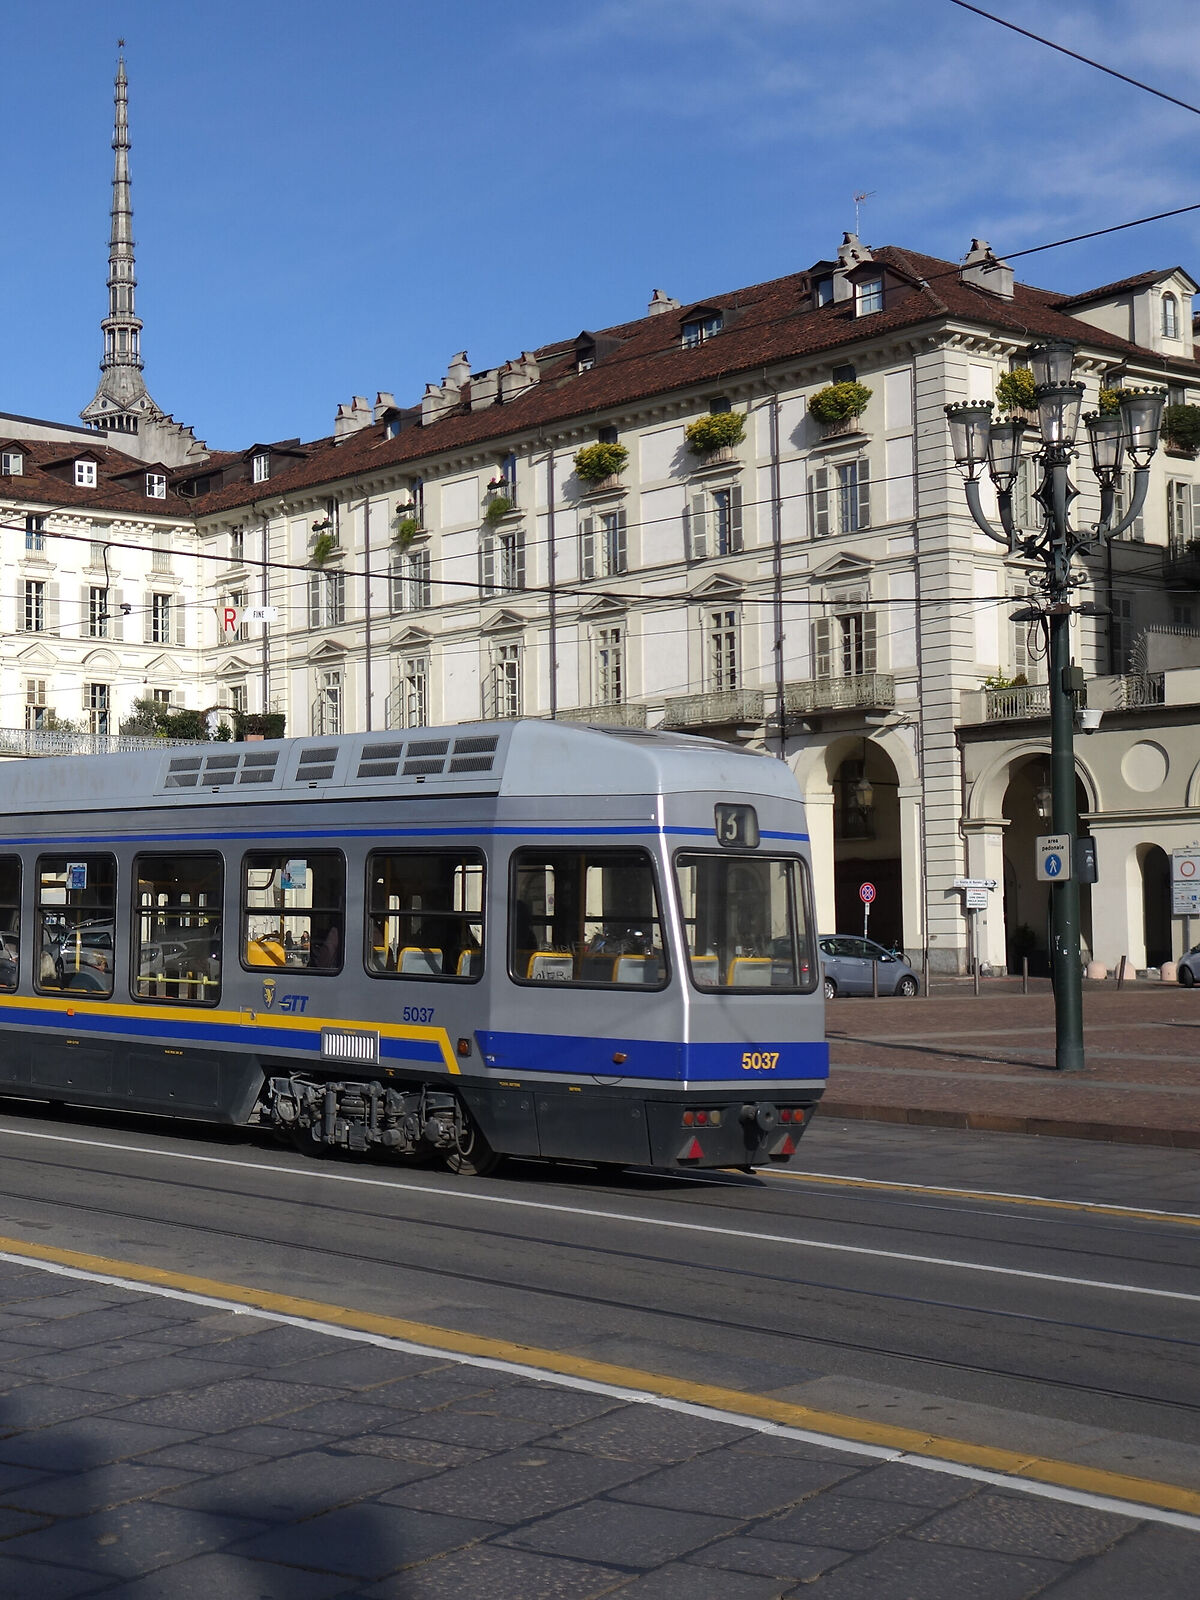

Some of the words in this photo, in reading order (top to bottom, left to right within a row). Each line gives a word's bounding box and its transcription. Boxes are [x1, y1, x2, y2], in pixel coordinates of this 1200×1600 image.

[224, 608, 236, 631] R
[253, 610, 264, 619] FINE
[278, 994, 309, 1012] GTT
[403, 1007, 434, 1022] 5037
[742, 1052, 780, 1070] 5037
